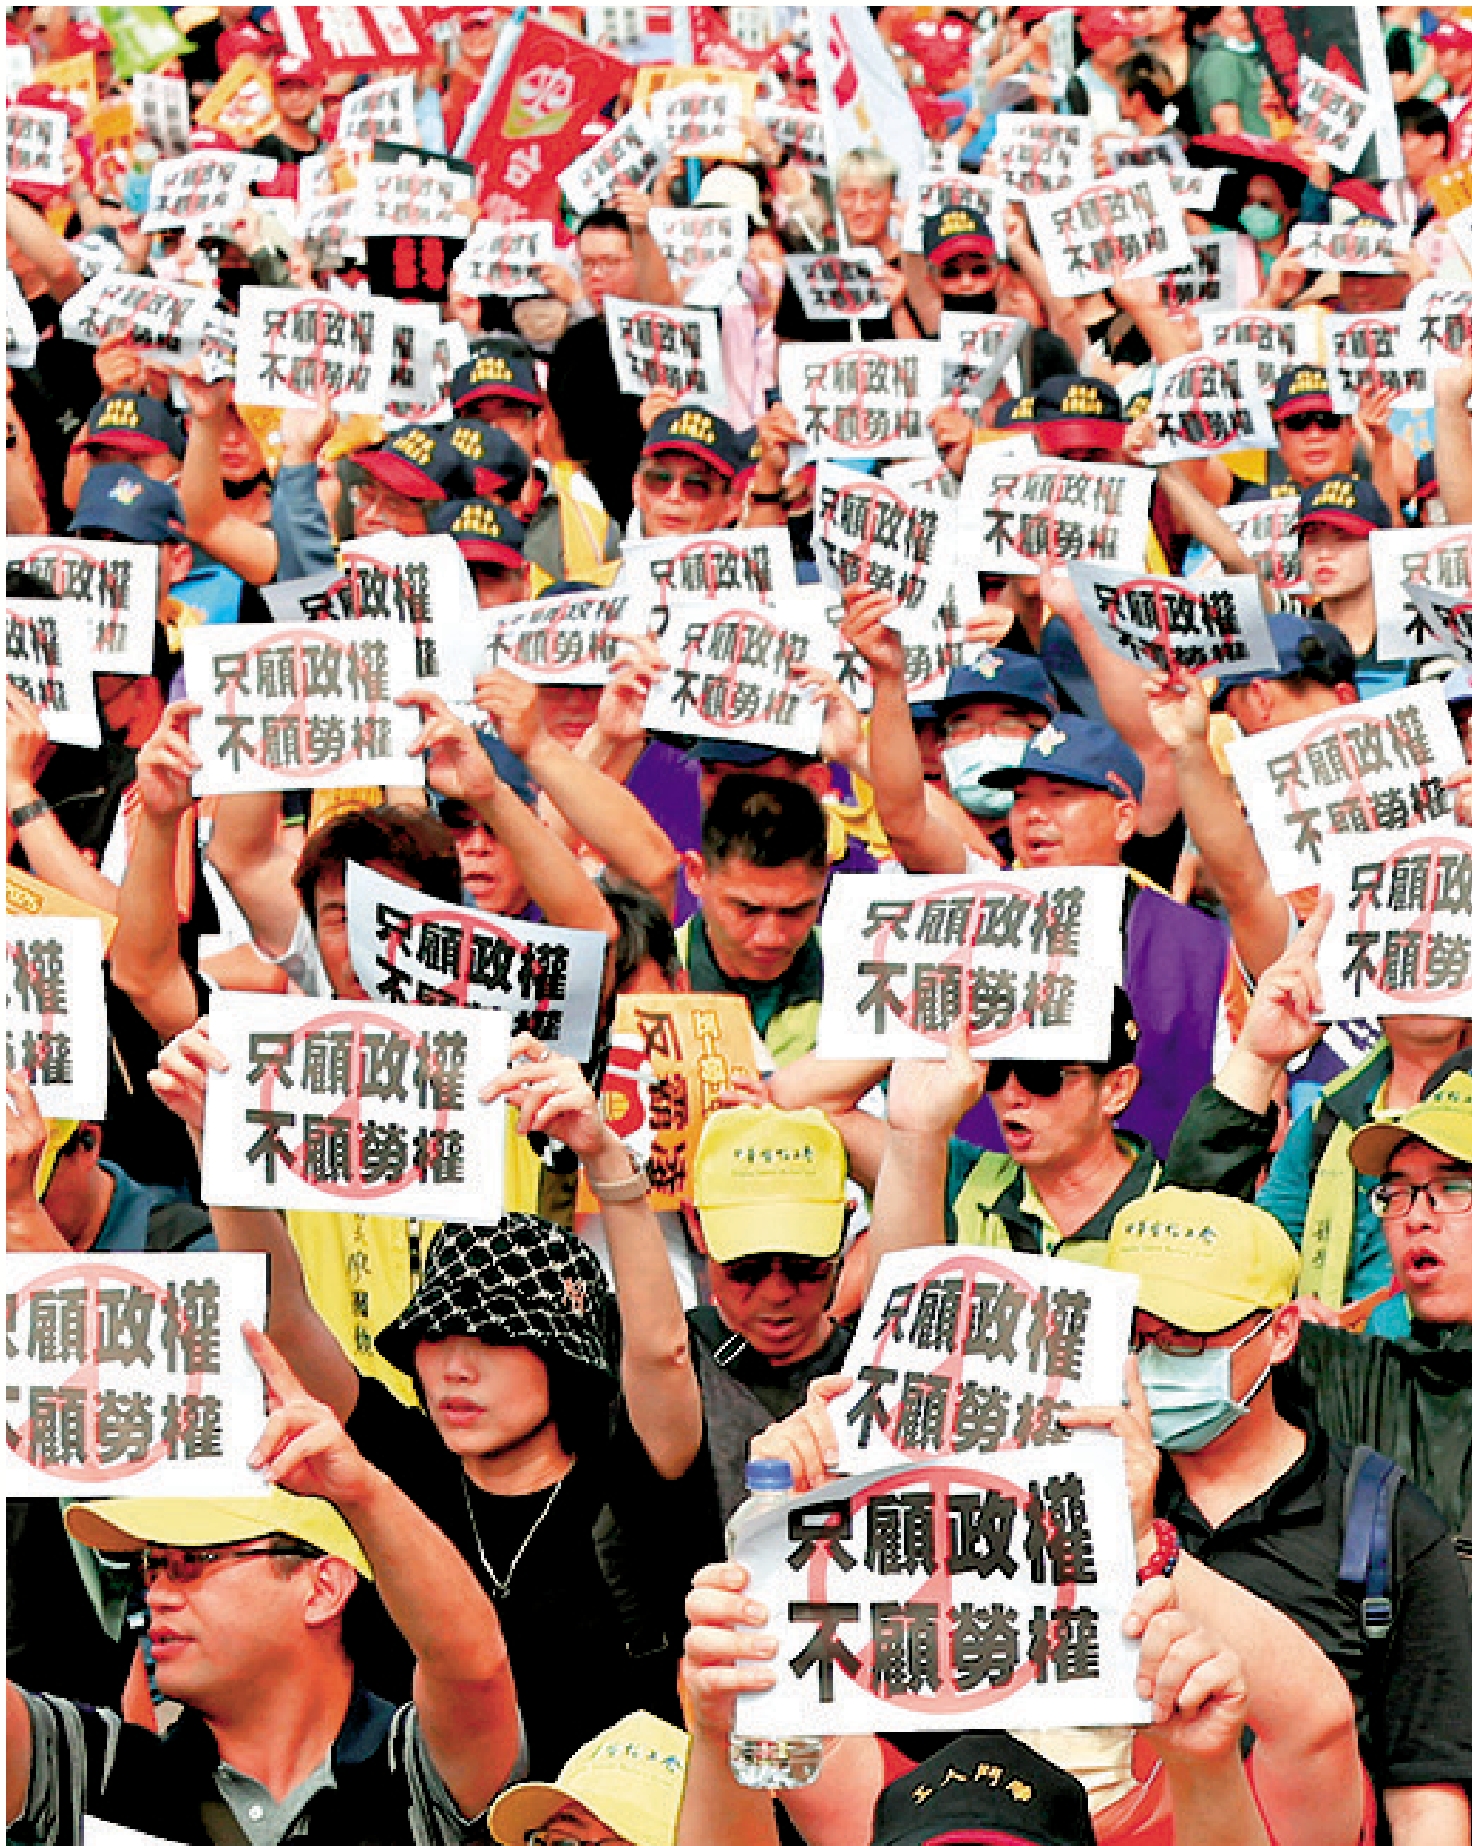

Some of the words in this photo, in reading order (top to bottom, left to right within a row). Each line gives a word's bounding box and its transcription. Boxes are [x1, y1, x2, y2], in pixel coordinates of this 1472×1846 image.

[1050, 181, 1159, 234] 只顧政權
[1068, 231, 1168, 275] 不顧勞權
[261, 306, 375, 350] 只顧政權
[259, 350, 374, 397] 不顧勞權
[803, 359, 919, 398] 只顧政權
[803, 405, 922, 441] 不顧勞權
[991, 472, 1126, 516] 只顧政權
[820, 484, 939, 566] 只顧政權
[982, 509, 1119, 562] 不顧勞權
[1092, 583, 1242, 636] 只顧政權
[211, 641, 390, 701] 只顧政權
[681, 621, 811, 676] 只顧政權
[669, 668, 801, 726] 不顧勞權
[214, 709, 393, 772] 不顧勞權
[1265, 705, 1438, 796] 只顧政權
[375, 902, 571, 1002] 只顧政權
[863, 889, 1082, 958] 只顧政權
[856, 962, 1076, 1035] 不顧勞權
[246, 1030, 468, 1111] 只顧政權
[244, 1108, 466, 1187] 不顧勞權
[871, 1280, 1092, 1382] 只顧政權
[785, 1472, 1098, 1585] 只顧政權
[788, 1597, 1100, 1704] 不顧勞權
